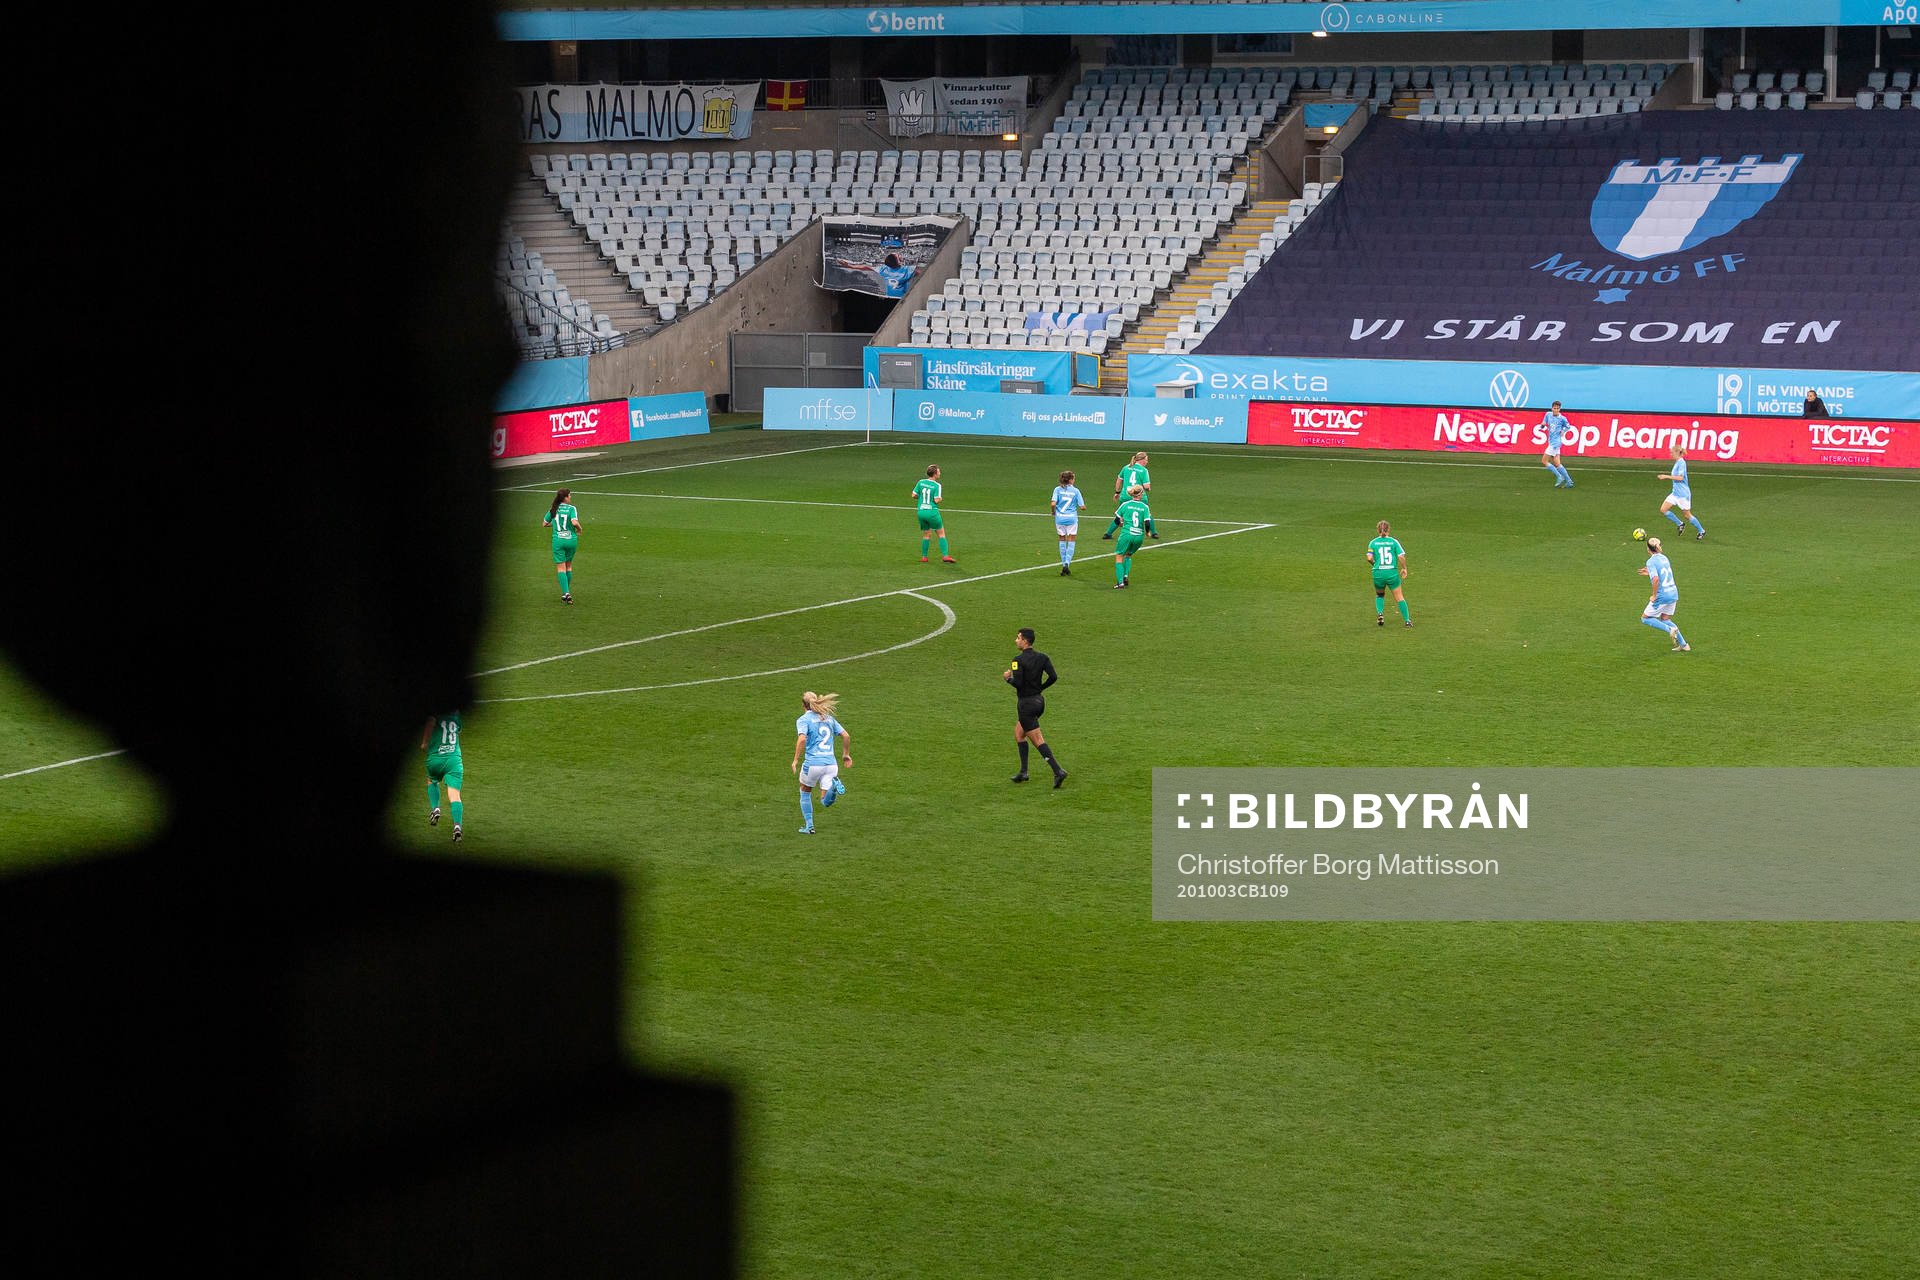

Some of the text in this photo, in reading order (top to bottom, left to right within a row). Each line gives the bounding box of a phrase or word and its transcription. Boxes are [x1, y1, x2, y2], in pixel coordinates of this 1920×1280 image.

[891, 12, 945, 31] bemt
[1355, 14, 1444, 24] CABONLINE
[943, 83, 1012, 91] Vinnarkultur
[586, 85, 696, 139] MALMÖ
[1530, 252, 1747, 285] Malmö FF
[1350, 314, 1842, 344] VI STÅR SOM EN
[927, 360, 1036, 379] Länsförsäkringar
[927, 375, 967, 390] Skåne
[1210, 369, 1328, 392] exakta
[1757, 384, 1777, 396] EN
[800, 398, 857, 421] mff.se
[1022, 410, 1037, 423] Följ
[1038, 413, 1051, 421] oss
[1291, 408, 1364, 430] TICTAC
[549, 408, 599, 432] TICTAC
[1301, 437, 1345, 445] INTERACTIVE
[1433, 412, 1740, 459] Never sop learning
[1808, 424, 1890, 447] TICTAC
[1820, 455, 1870, 463] INTERACTIVE
[1129, 471, 1137, 486] 4
[921, 487, 932, 505] 11
[1060, 496, 1073, 513] 7
[555, 513, 569, 532] 17
[1132, 511, 1140, 528] 6
[1378, 546, 1393, 565] 15
[440, 720, 457, 744] 18
[818, 726, 831, 750] 2
